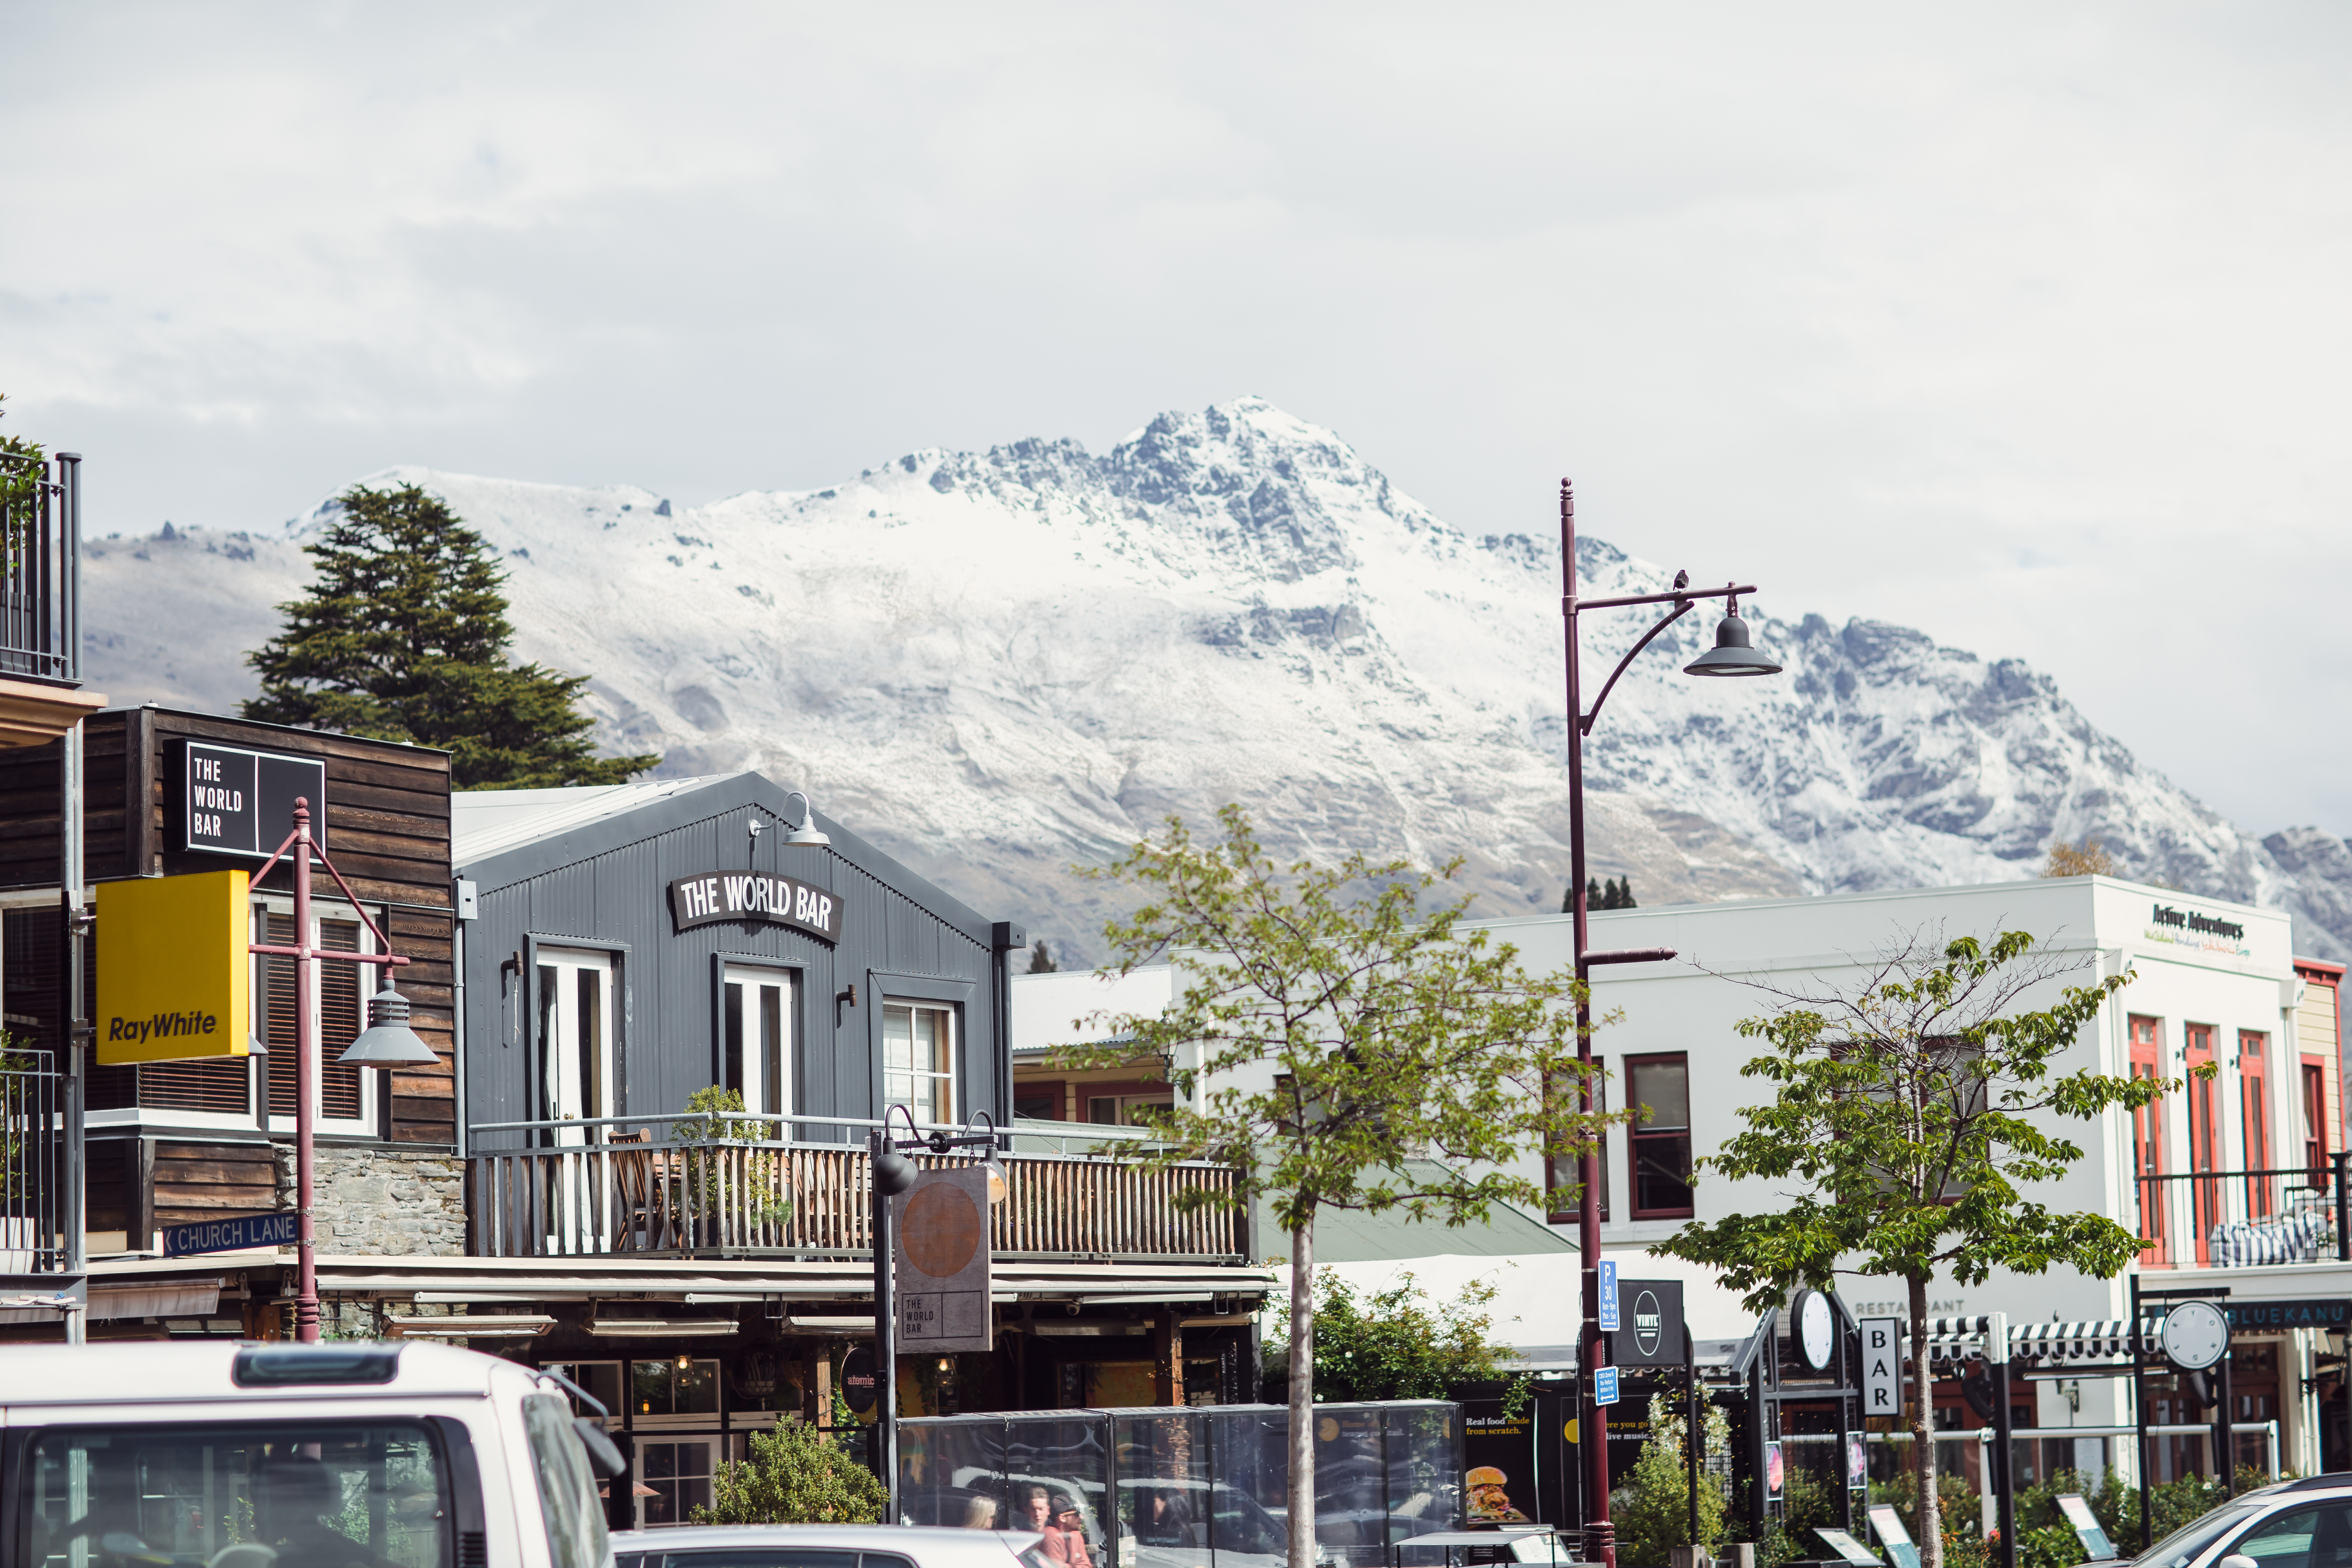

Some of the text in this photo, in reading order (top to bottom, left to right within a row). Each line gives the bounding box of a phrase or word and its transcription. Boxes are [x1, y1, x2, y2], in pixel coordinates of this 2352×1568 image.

[194, 758, 220, 782] THE
[194, 785, 242, 812] WORLD
[195, 813, 221, 837] BAR
[681, 876, 832, 931] THE WORLD BAR
[177, 1216, 295, 1250] CHURCH LANE
[1605, 1264, 1611, 1284] P
[1605, 1285, 1612, 1300] 30
[906, 1299, 921, 1309] THE
[1855, 1299, 1964, 1315] RESTAANT
[906, 1311, 934, 1321] WORLD
[1636, 1314, 1659, 1327] VINYL
[2228, 1306, 2343, 1324] BLUEKANU
[906, 1323, 922, 1334] BAR
[1872, 1330, 1889, 1406] BAR
[848, 1374, 875, 1385] atomic
[1466, 1417, 1485, 1426] Real
[1487, 1416, 1506, 1425] food
[1488, 1426, 1521, 1435] scratch.
